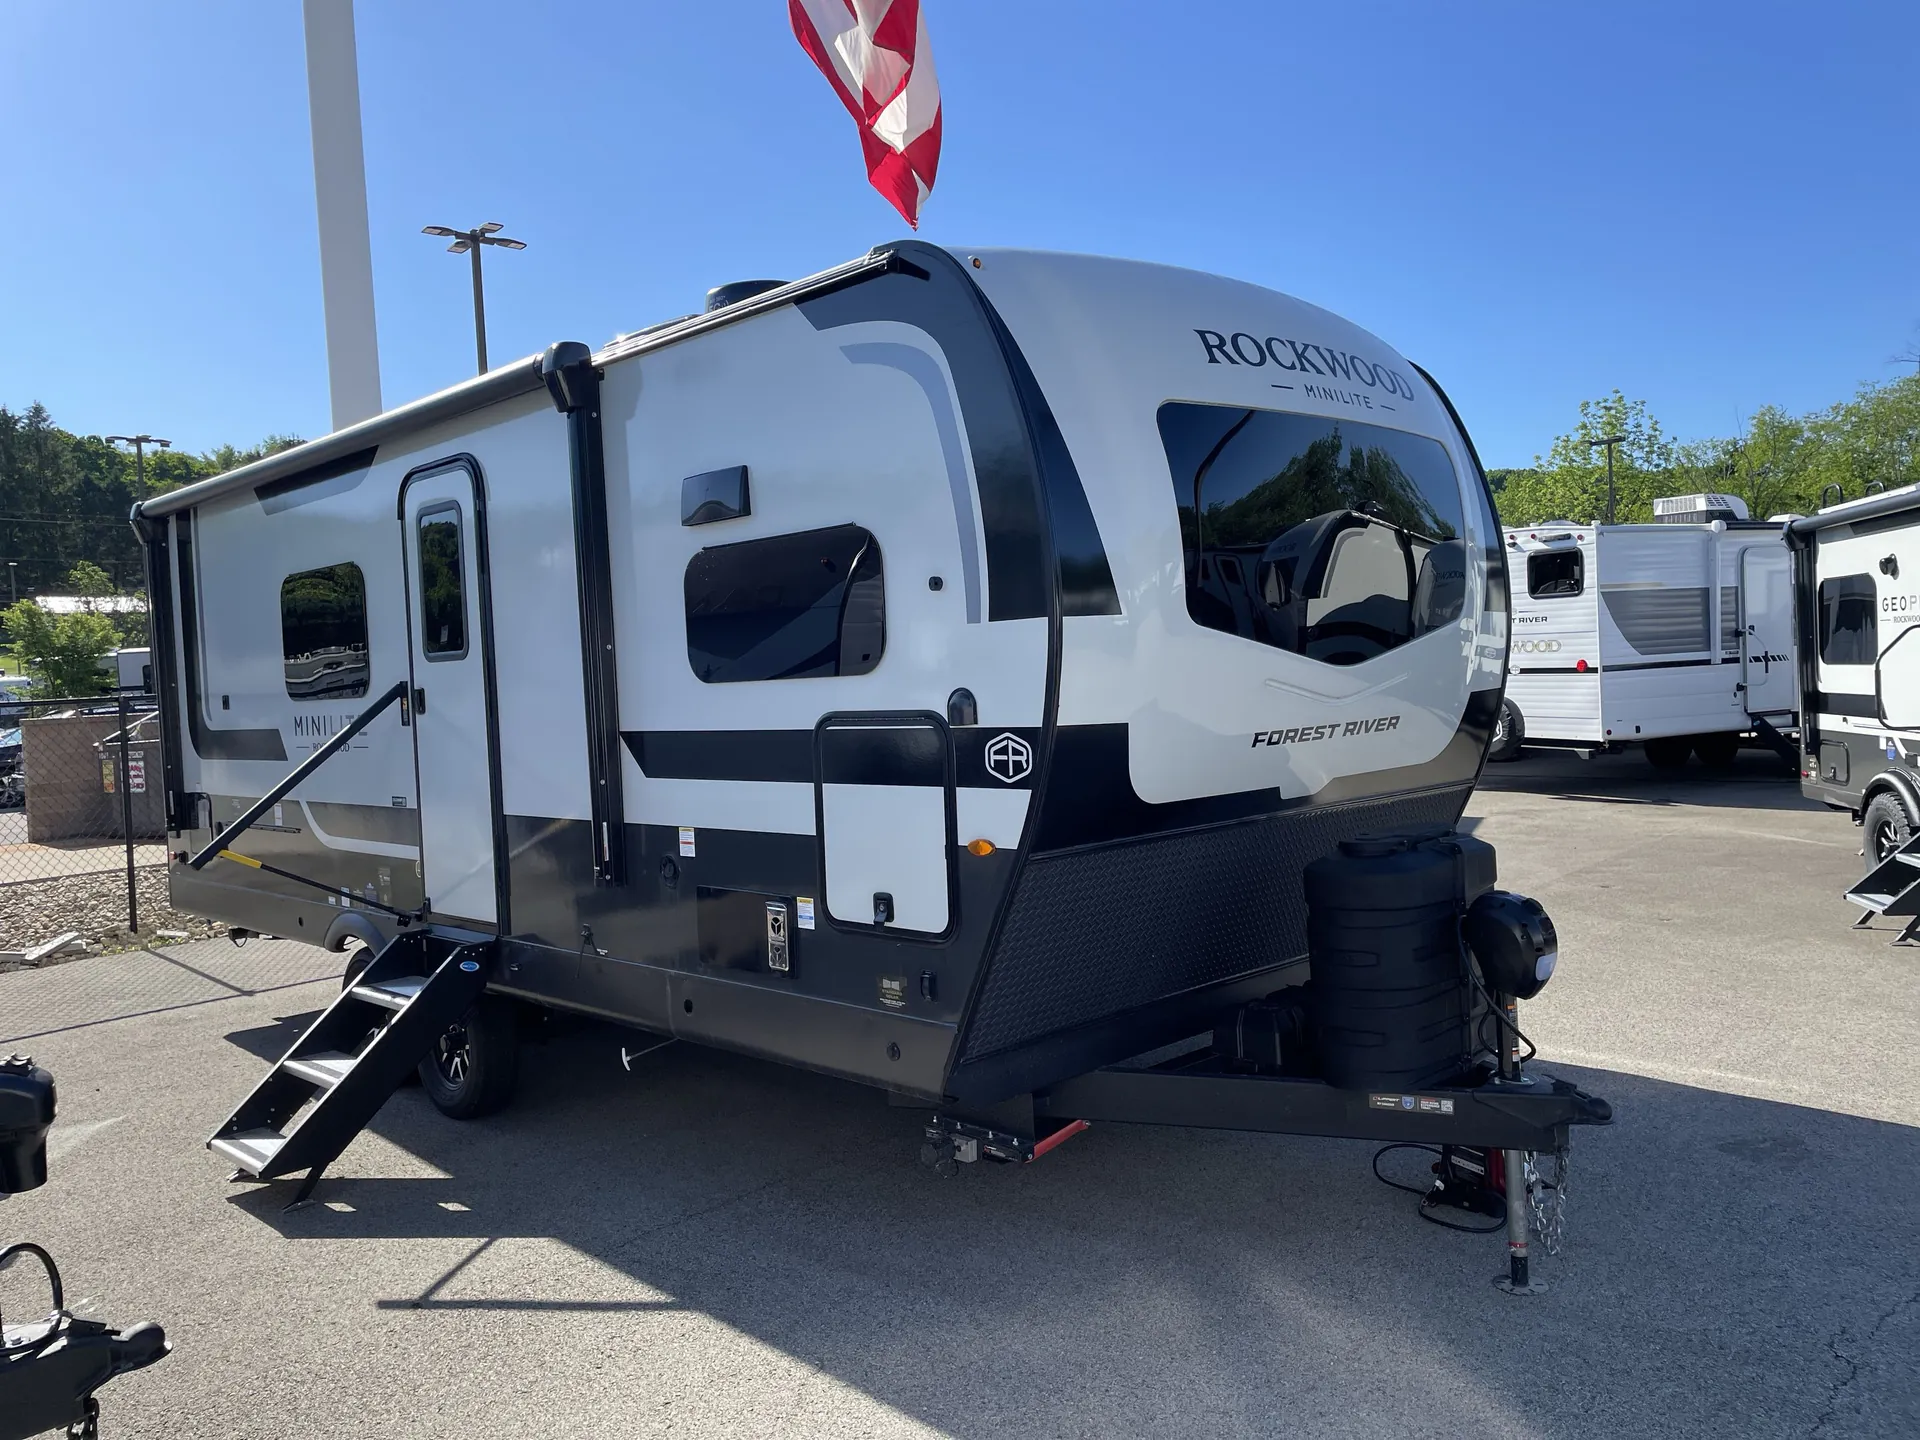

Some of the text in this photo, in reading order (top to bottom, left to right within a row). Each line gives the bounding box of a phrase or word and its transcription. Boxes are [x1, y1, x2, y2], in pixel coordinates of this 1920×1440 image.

[1193, 329, 1415, 402] ROCKWOOD
[1303, 384, 1374, 410] MINILITE
[1882, 594, 1920, 612] GEOP
[1518, 616, 1548, 624] RIVER
[1893, 614, 1920, 624] ROCKWOO
[1511, 639, 1562, 653] WOOD
[1251, 715, 1400, 748] FOREST RIVER
